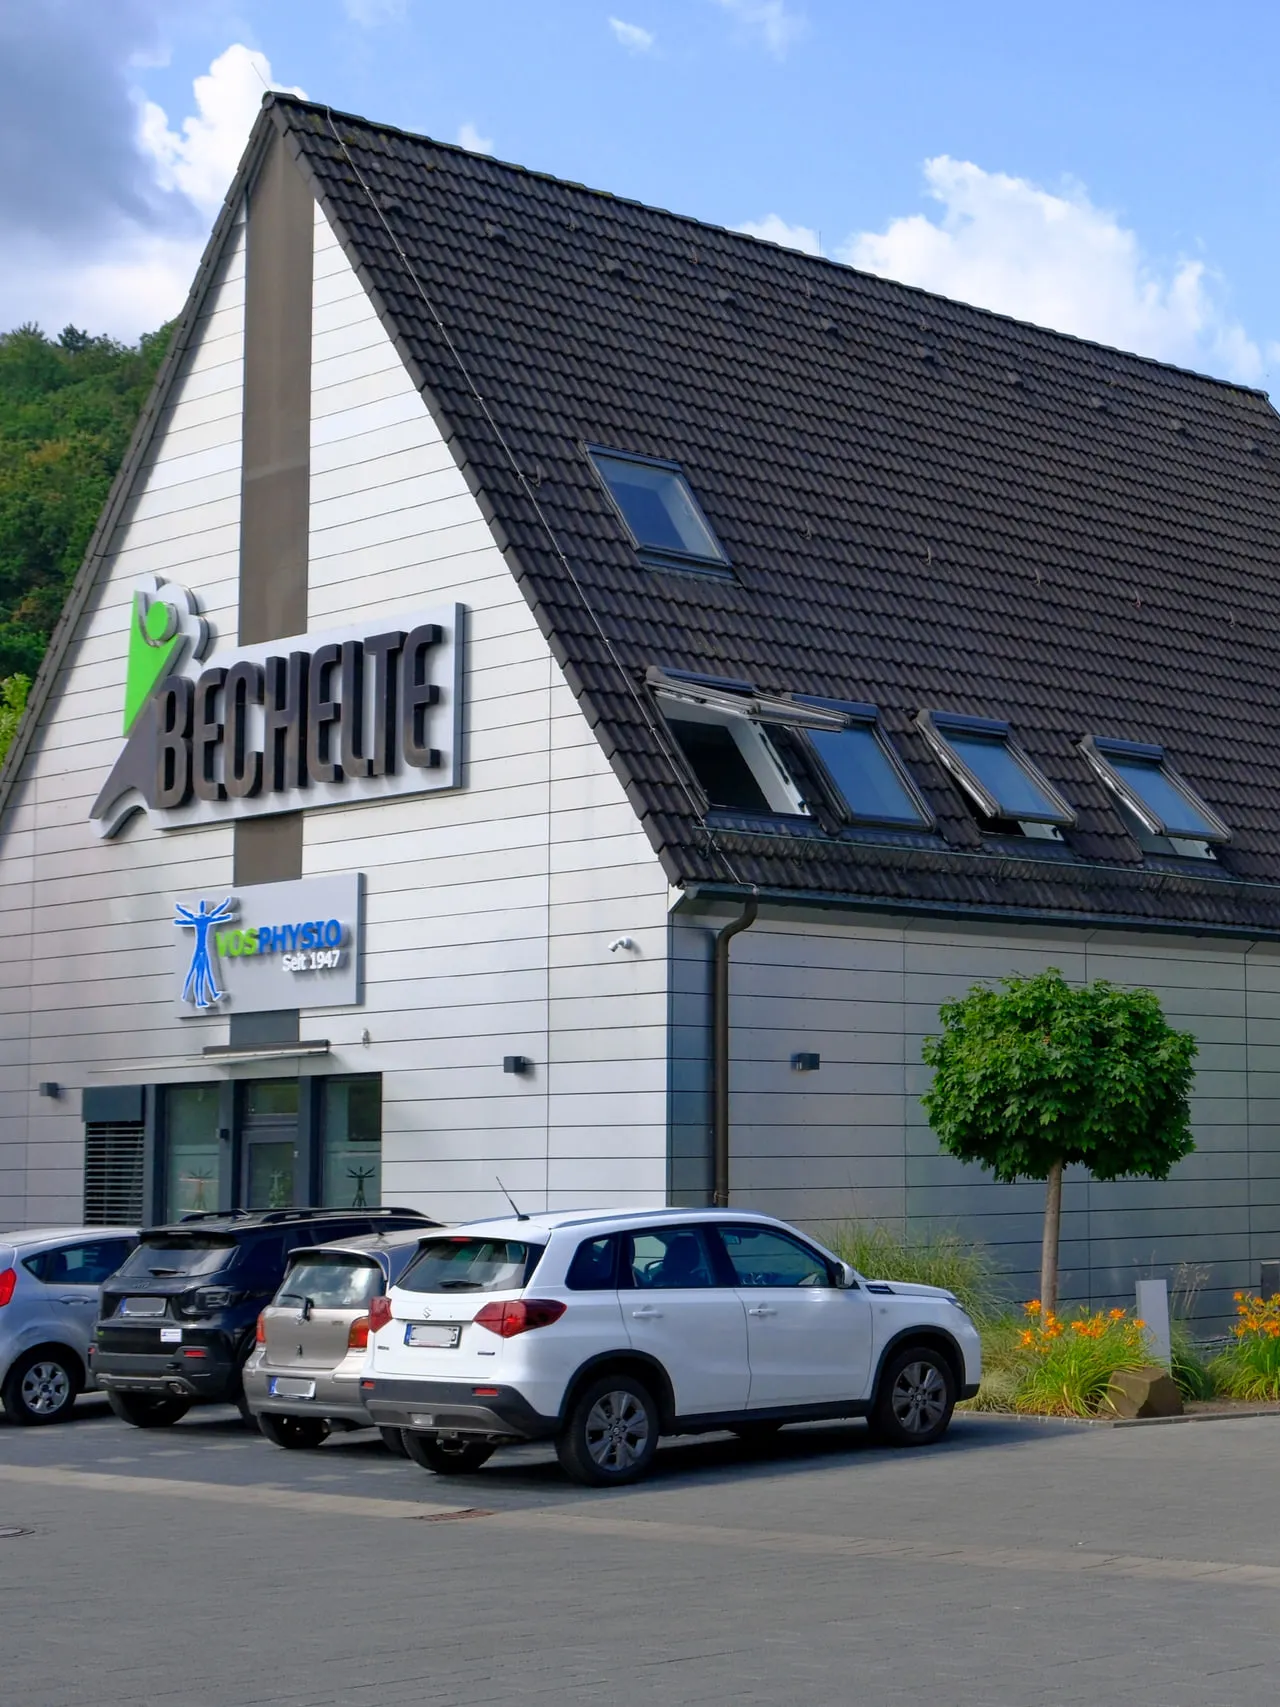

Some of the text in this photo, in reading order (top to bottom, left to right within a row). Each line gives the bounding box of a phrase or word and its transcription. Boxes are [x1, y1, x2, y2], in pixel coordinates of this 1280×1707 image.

[154, 623, 444, 810] BECHELTE
[215, 918, 342, 957] VOSPHYSIO
[282, 949, 340, 972] Seit 1947
